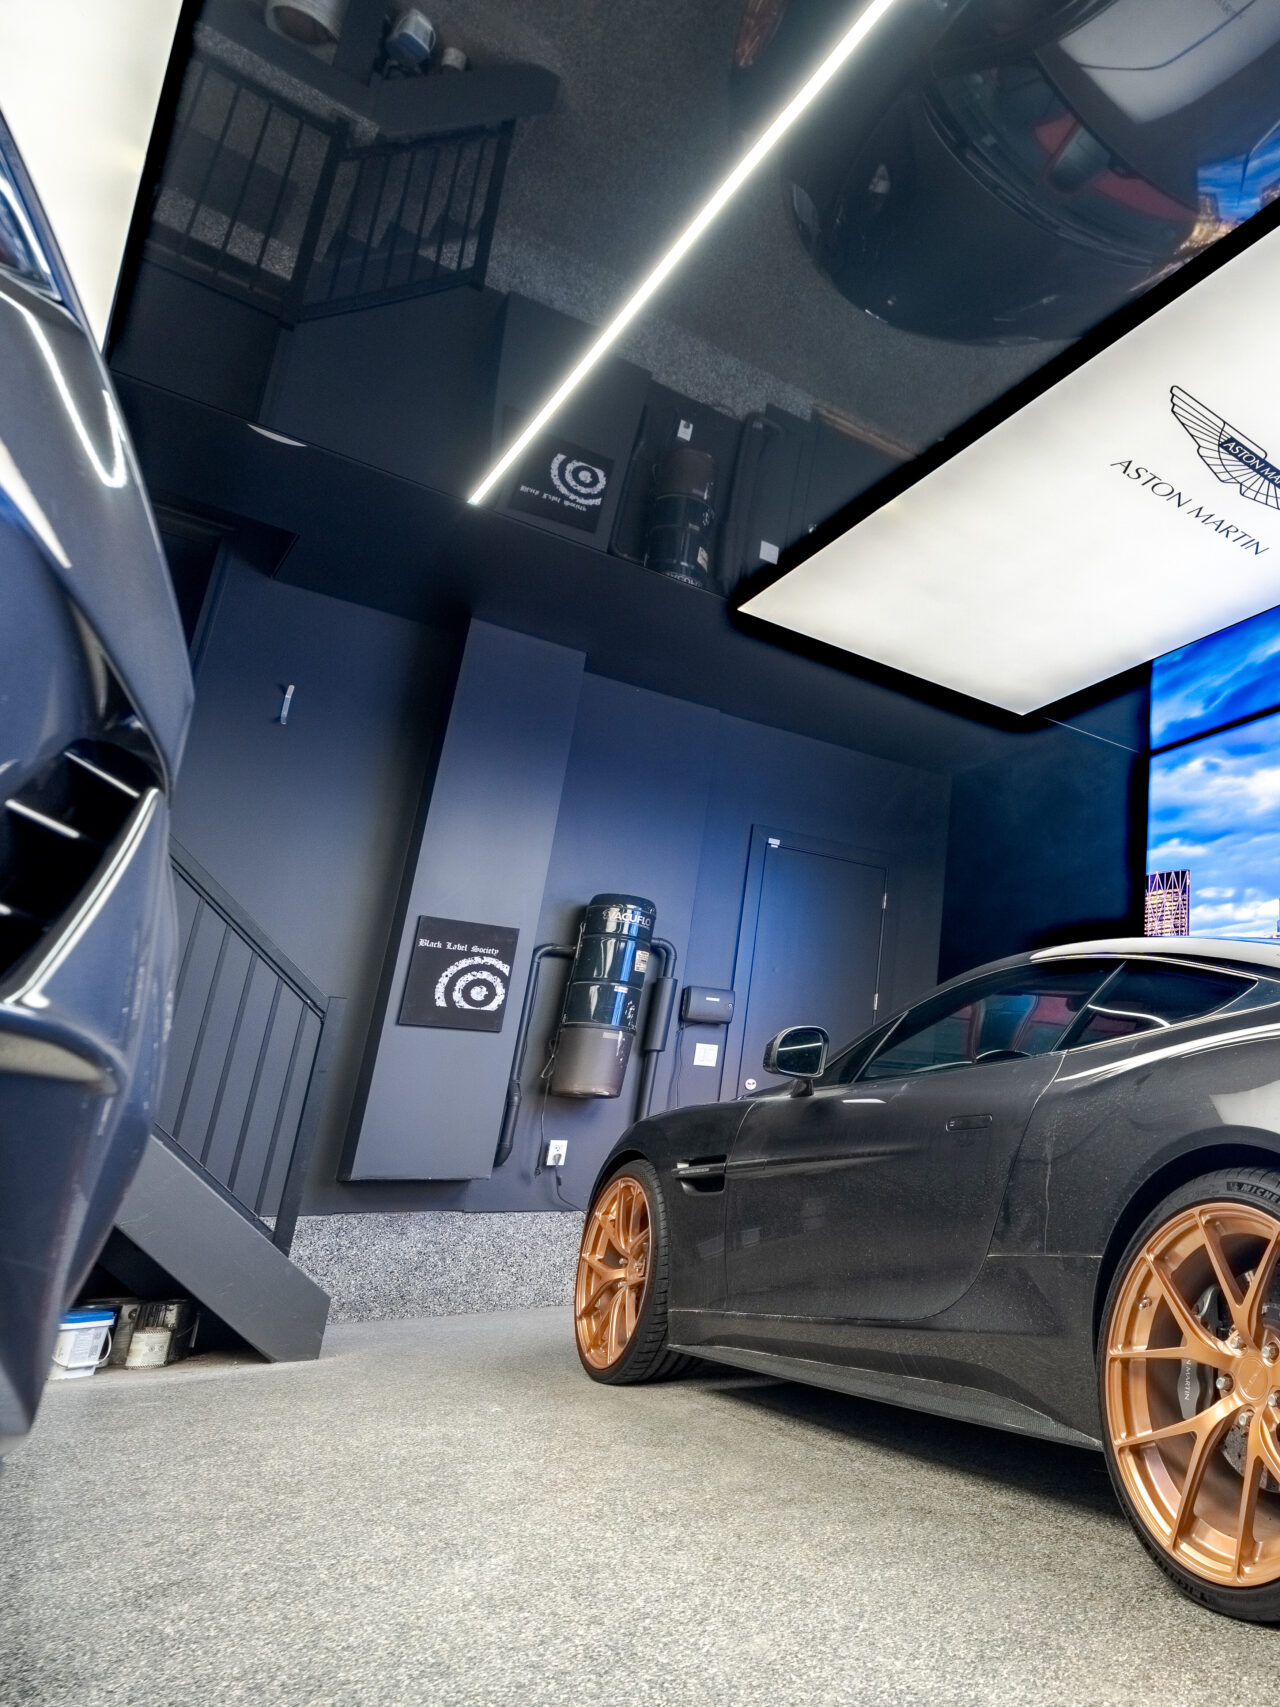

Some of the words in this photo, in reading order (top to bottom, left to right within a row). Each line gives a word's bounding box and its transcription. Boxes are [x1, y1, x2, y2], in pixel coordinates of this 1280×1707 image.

[1222, 441, 1266, 470] ASTON
[1110, 459, 1193, 508] ASTON
[1187, 506, 1270, 556] MARTIN
[609, 911, 651, 927] VACUFLO
[418, 938, 442, 949] Black
[446, 941, 468, 952] Label
[470, 945, 499, 956] Society
[1184, 1366, 1192, 1400] MARTIN
